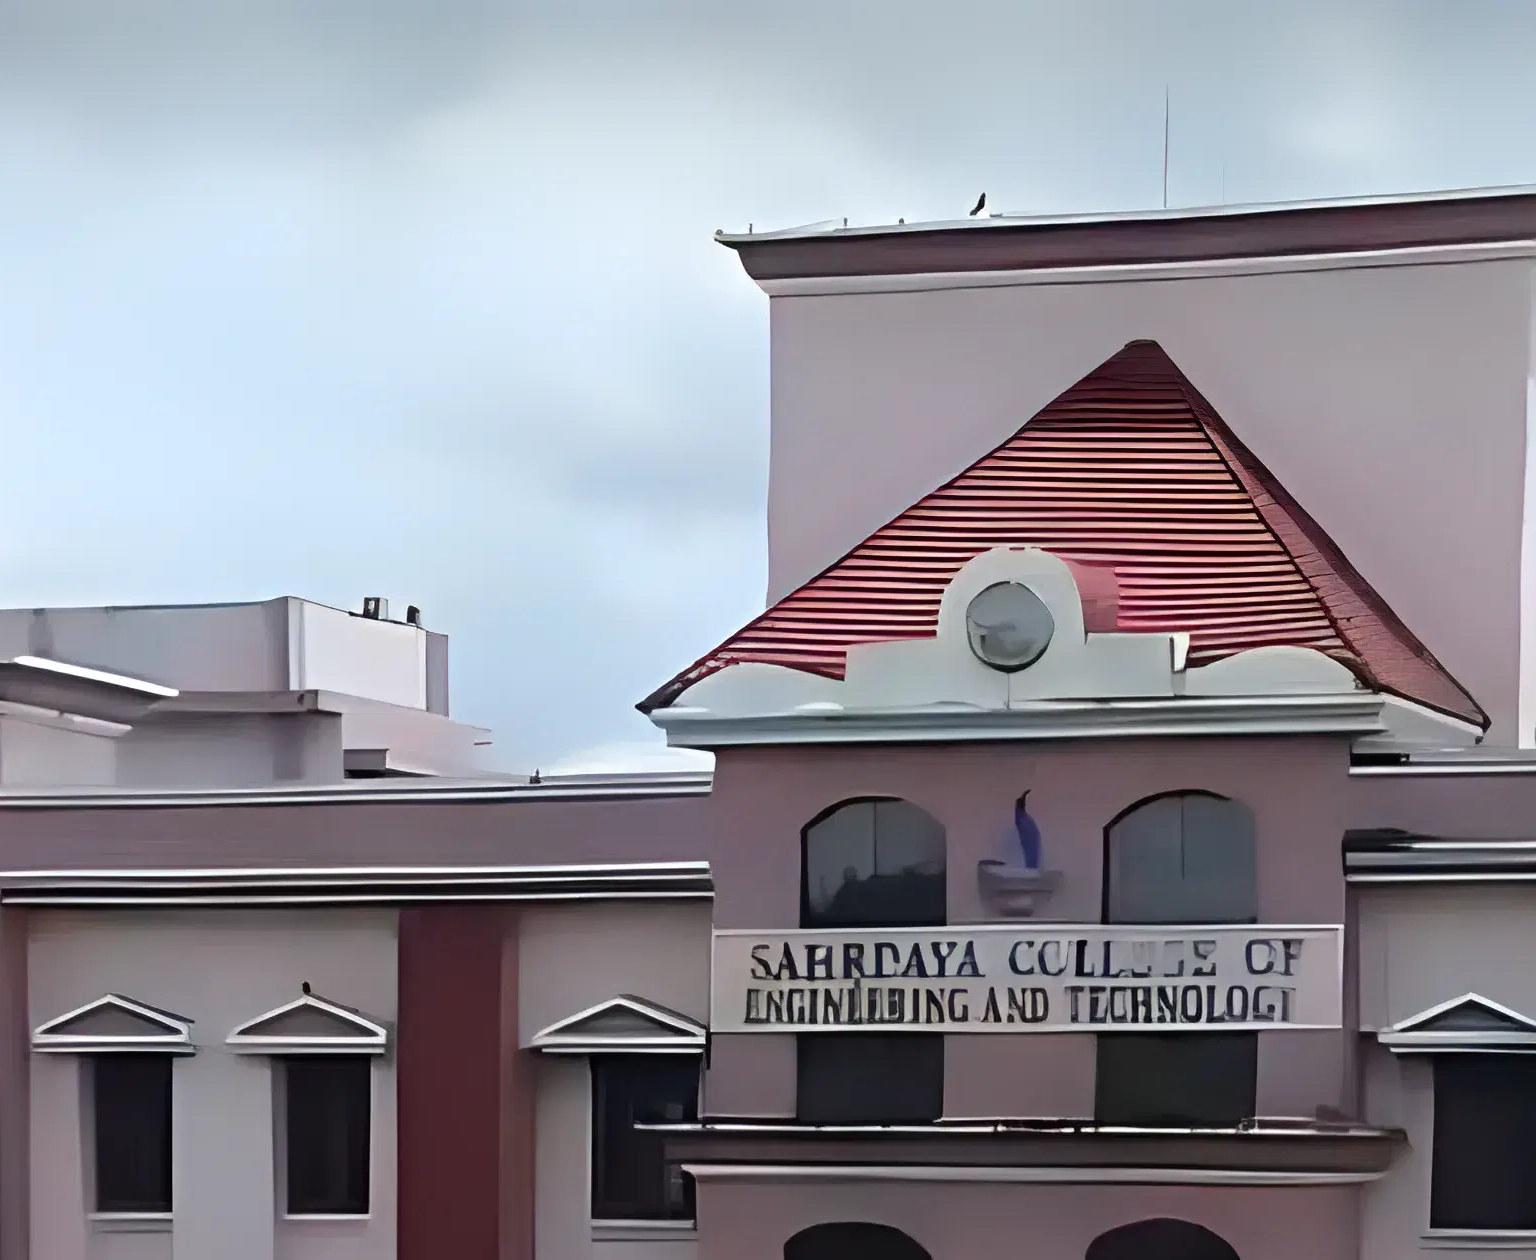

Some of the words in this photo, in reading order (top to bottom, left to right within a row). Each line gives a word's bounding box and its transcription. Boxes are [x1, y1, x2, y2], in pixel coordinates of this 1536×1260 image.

[750, 940, 985, 980] SAHRDAYA
[1245, 939, 1305, 976] OF
[979, 986, 1050, 1024] AND
